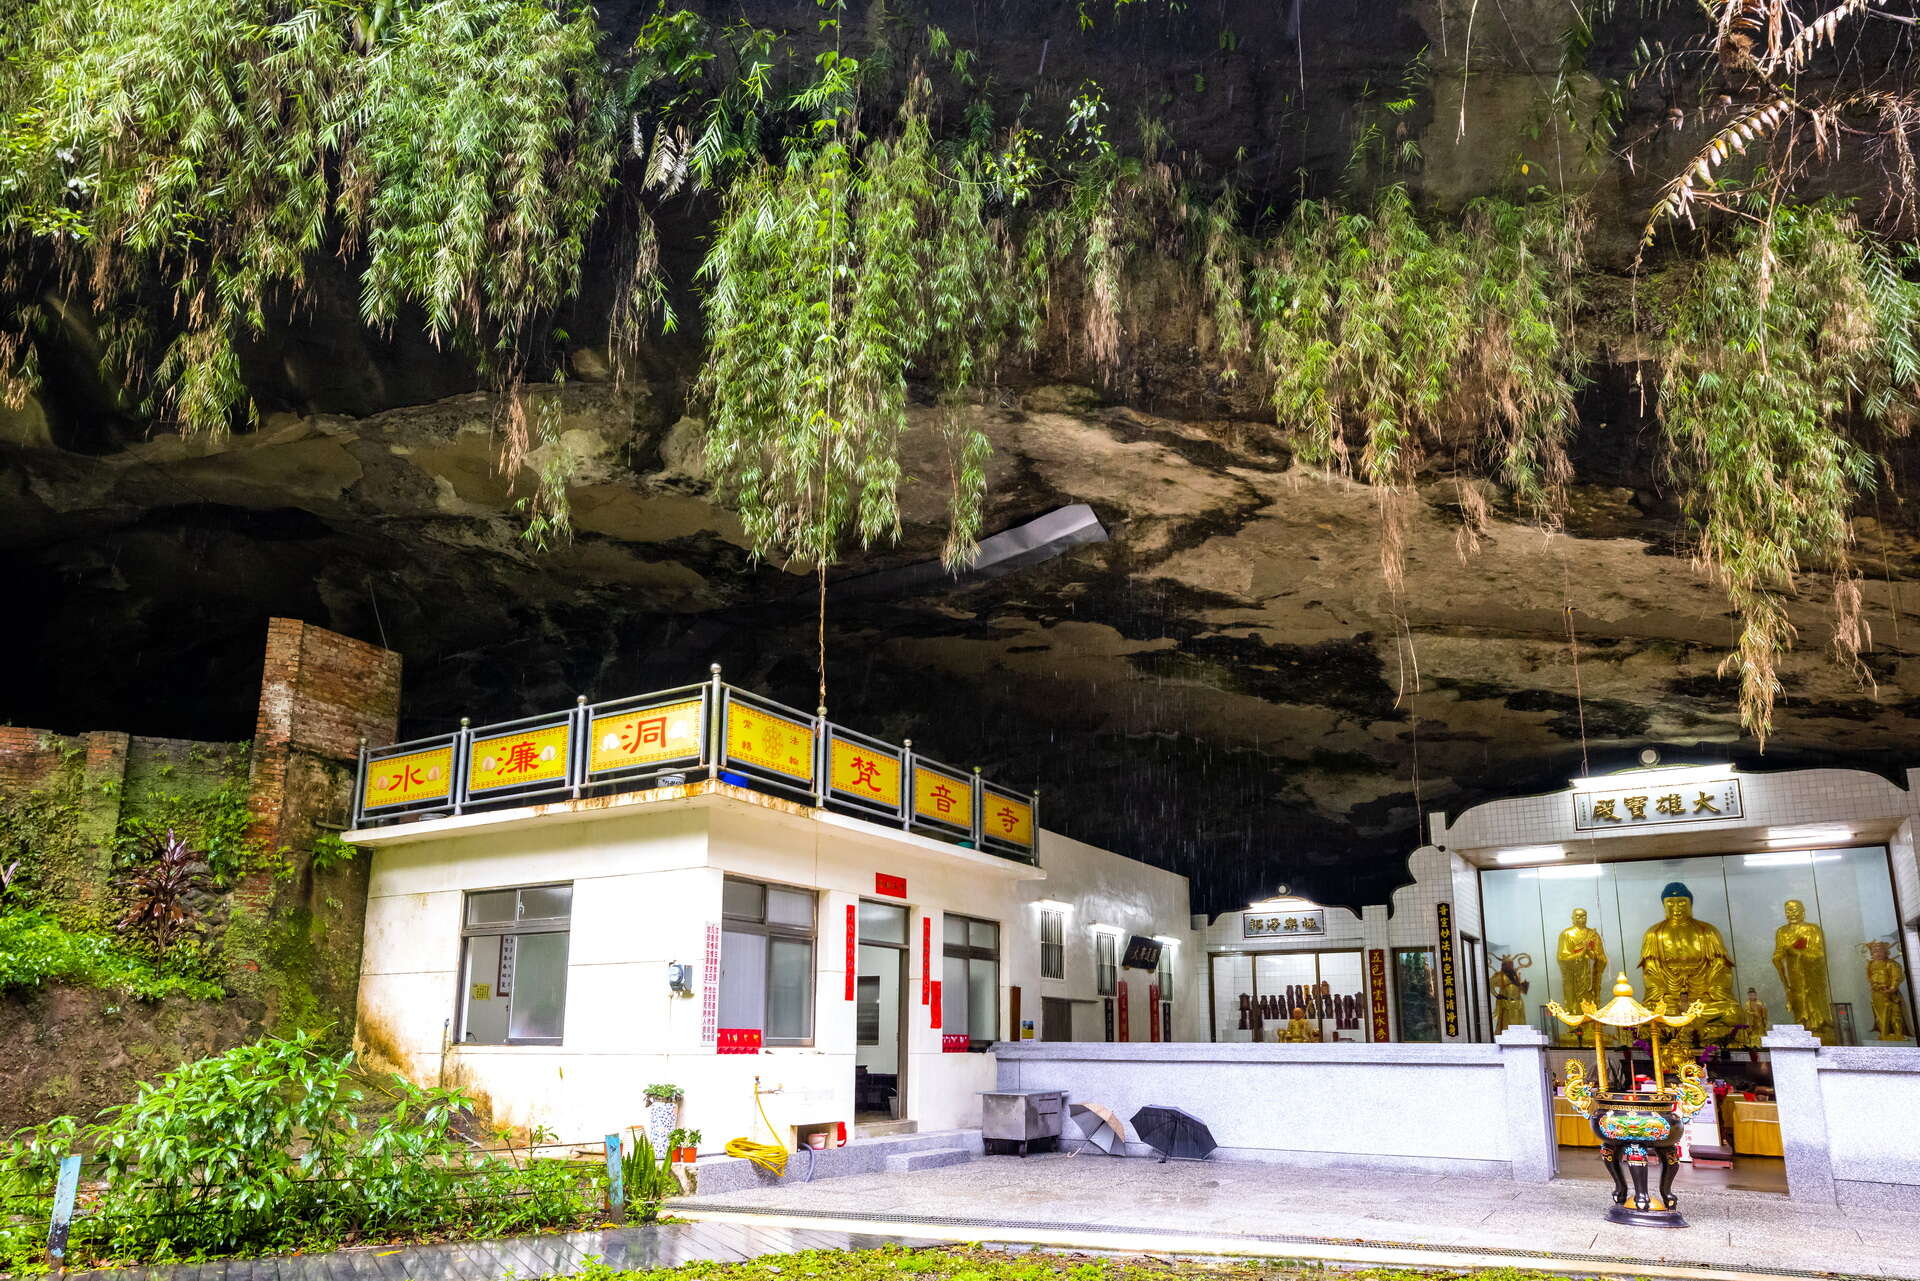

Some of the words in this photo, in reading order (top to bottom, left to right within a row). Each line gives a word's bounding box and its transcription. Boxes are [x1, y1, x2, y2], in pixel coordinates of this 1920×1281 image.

[387, 764, 425, 793] 水
[620, 715, 668, 754] 洞
[849, 755, 882, 794] 梵
[930, 784, 957, 814] 音
[996, 806, 1020, 833] 寺
